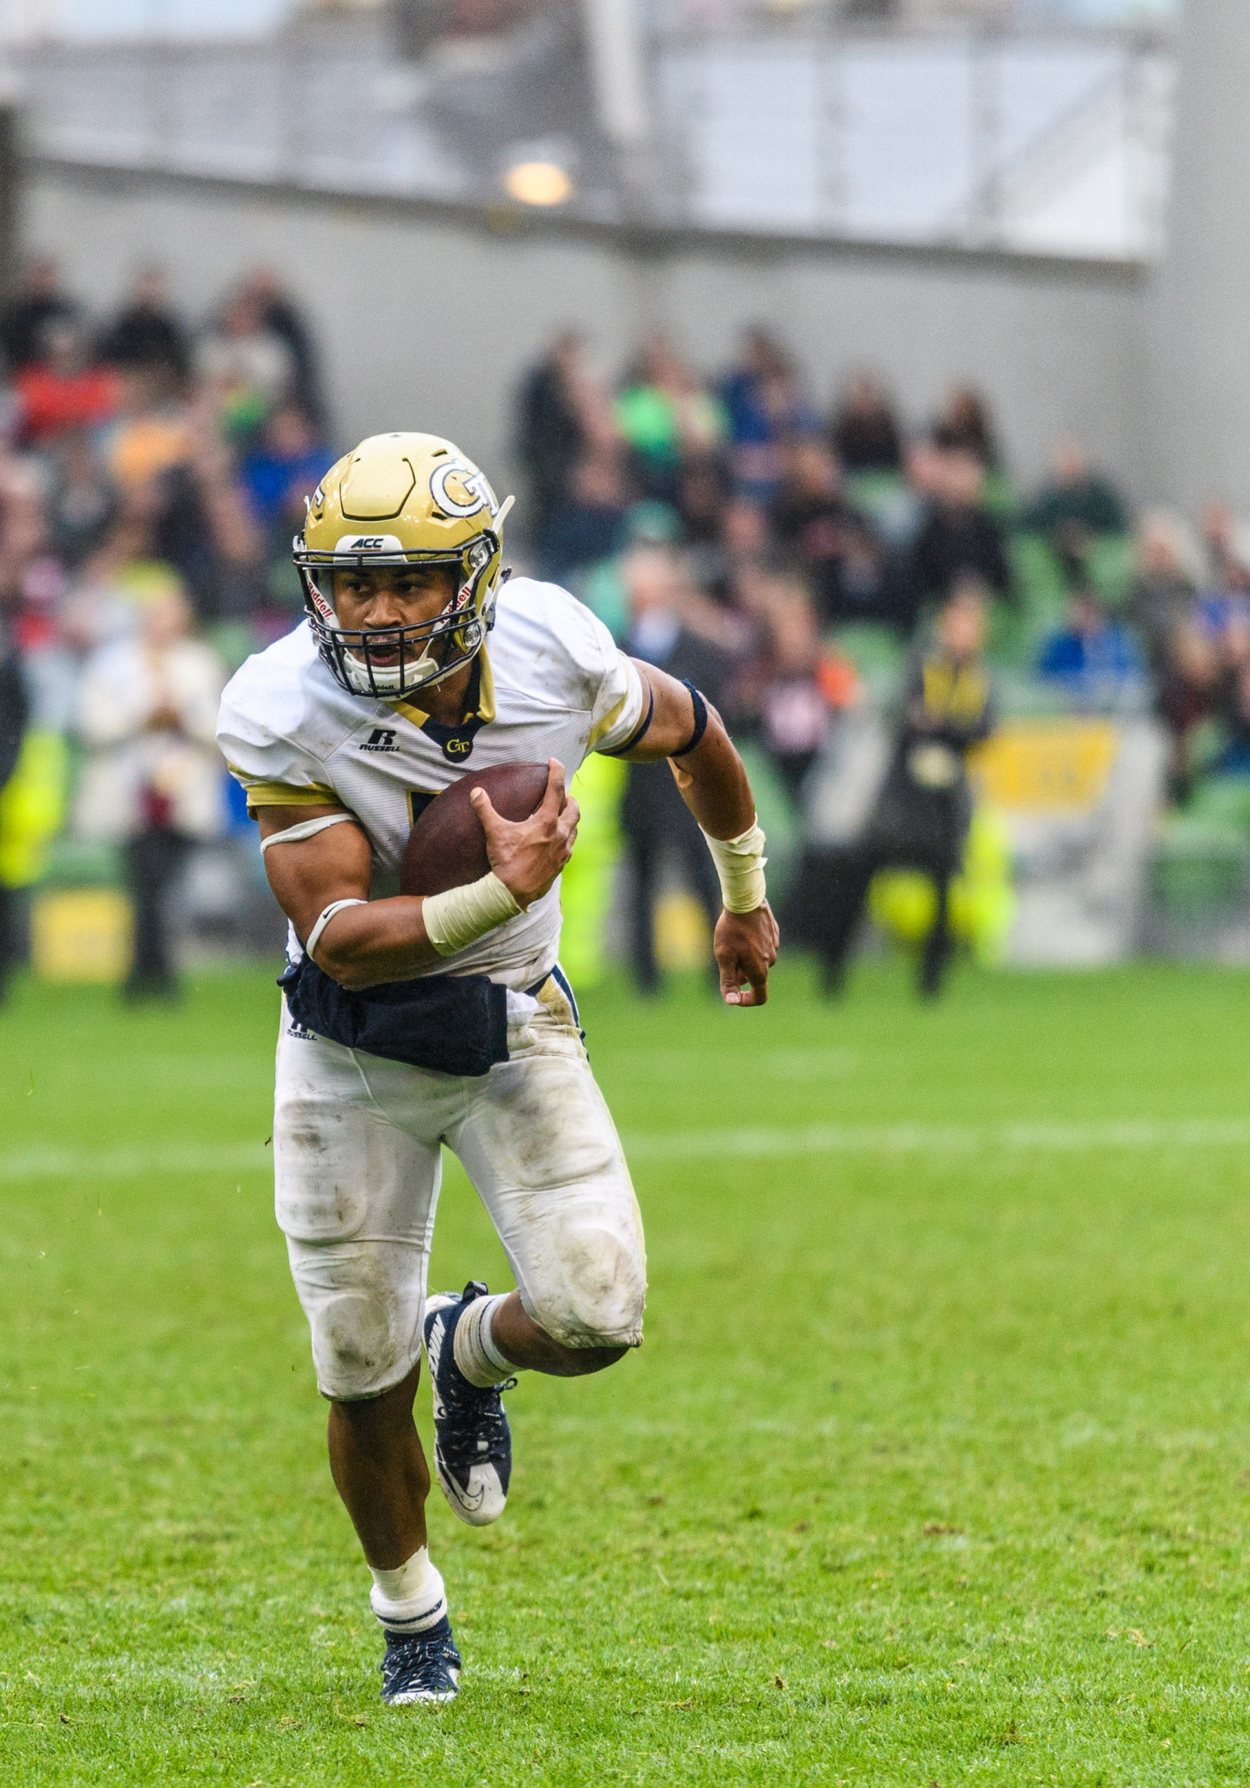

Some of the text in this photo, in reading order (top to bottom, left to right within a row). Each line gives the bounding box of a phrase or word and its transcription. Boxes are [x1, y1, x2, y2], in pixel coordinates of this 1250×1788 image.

[350, 537, 384, 549] ACC
[367, 728, 398, 746] R
[359, 743, 402, 752] RUSSELL
[446, 738, 470, 753] GT
